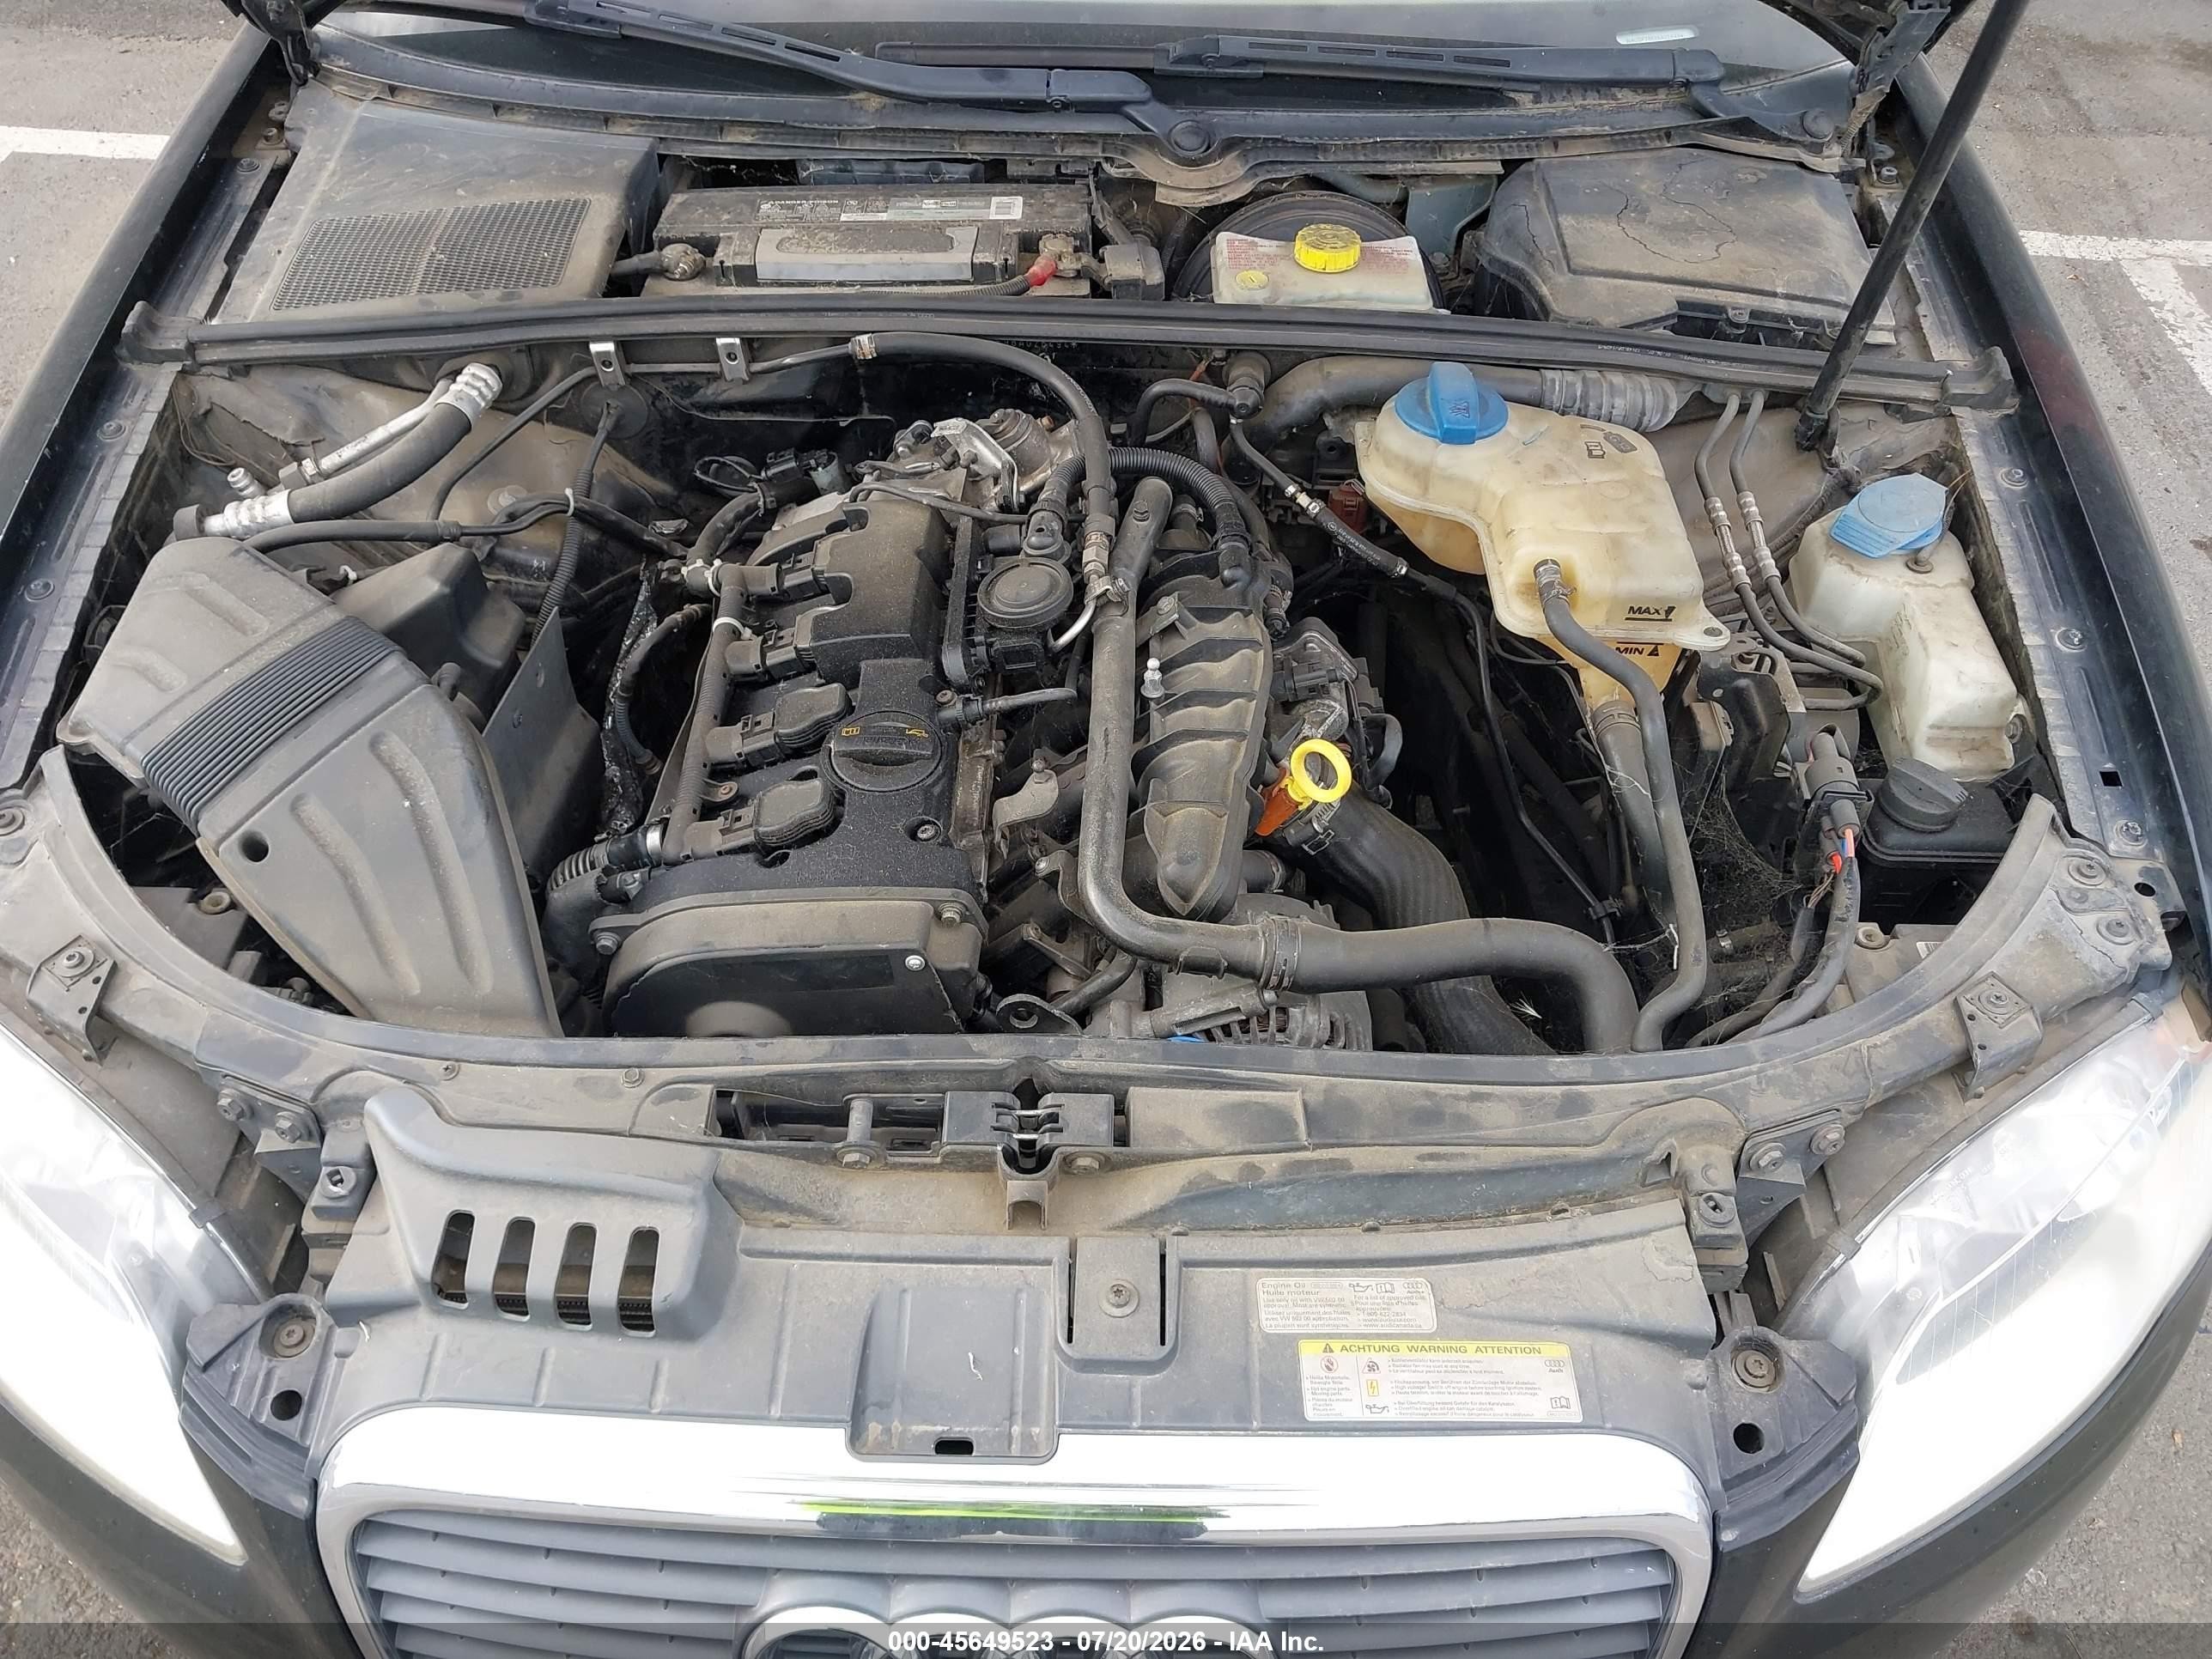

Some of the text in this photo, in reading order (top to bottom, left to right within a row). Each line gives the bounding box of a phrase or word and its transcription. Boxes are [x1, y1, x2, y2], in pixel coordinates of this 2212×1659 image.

[1628, 605, 1662, 616] MAX
[1615, 646, 1644, 655] MIN
[1340, 1344, 1542, 1354] ACHTUNG WARNING ATTENTION
